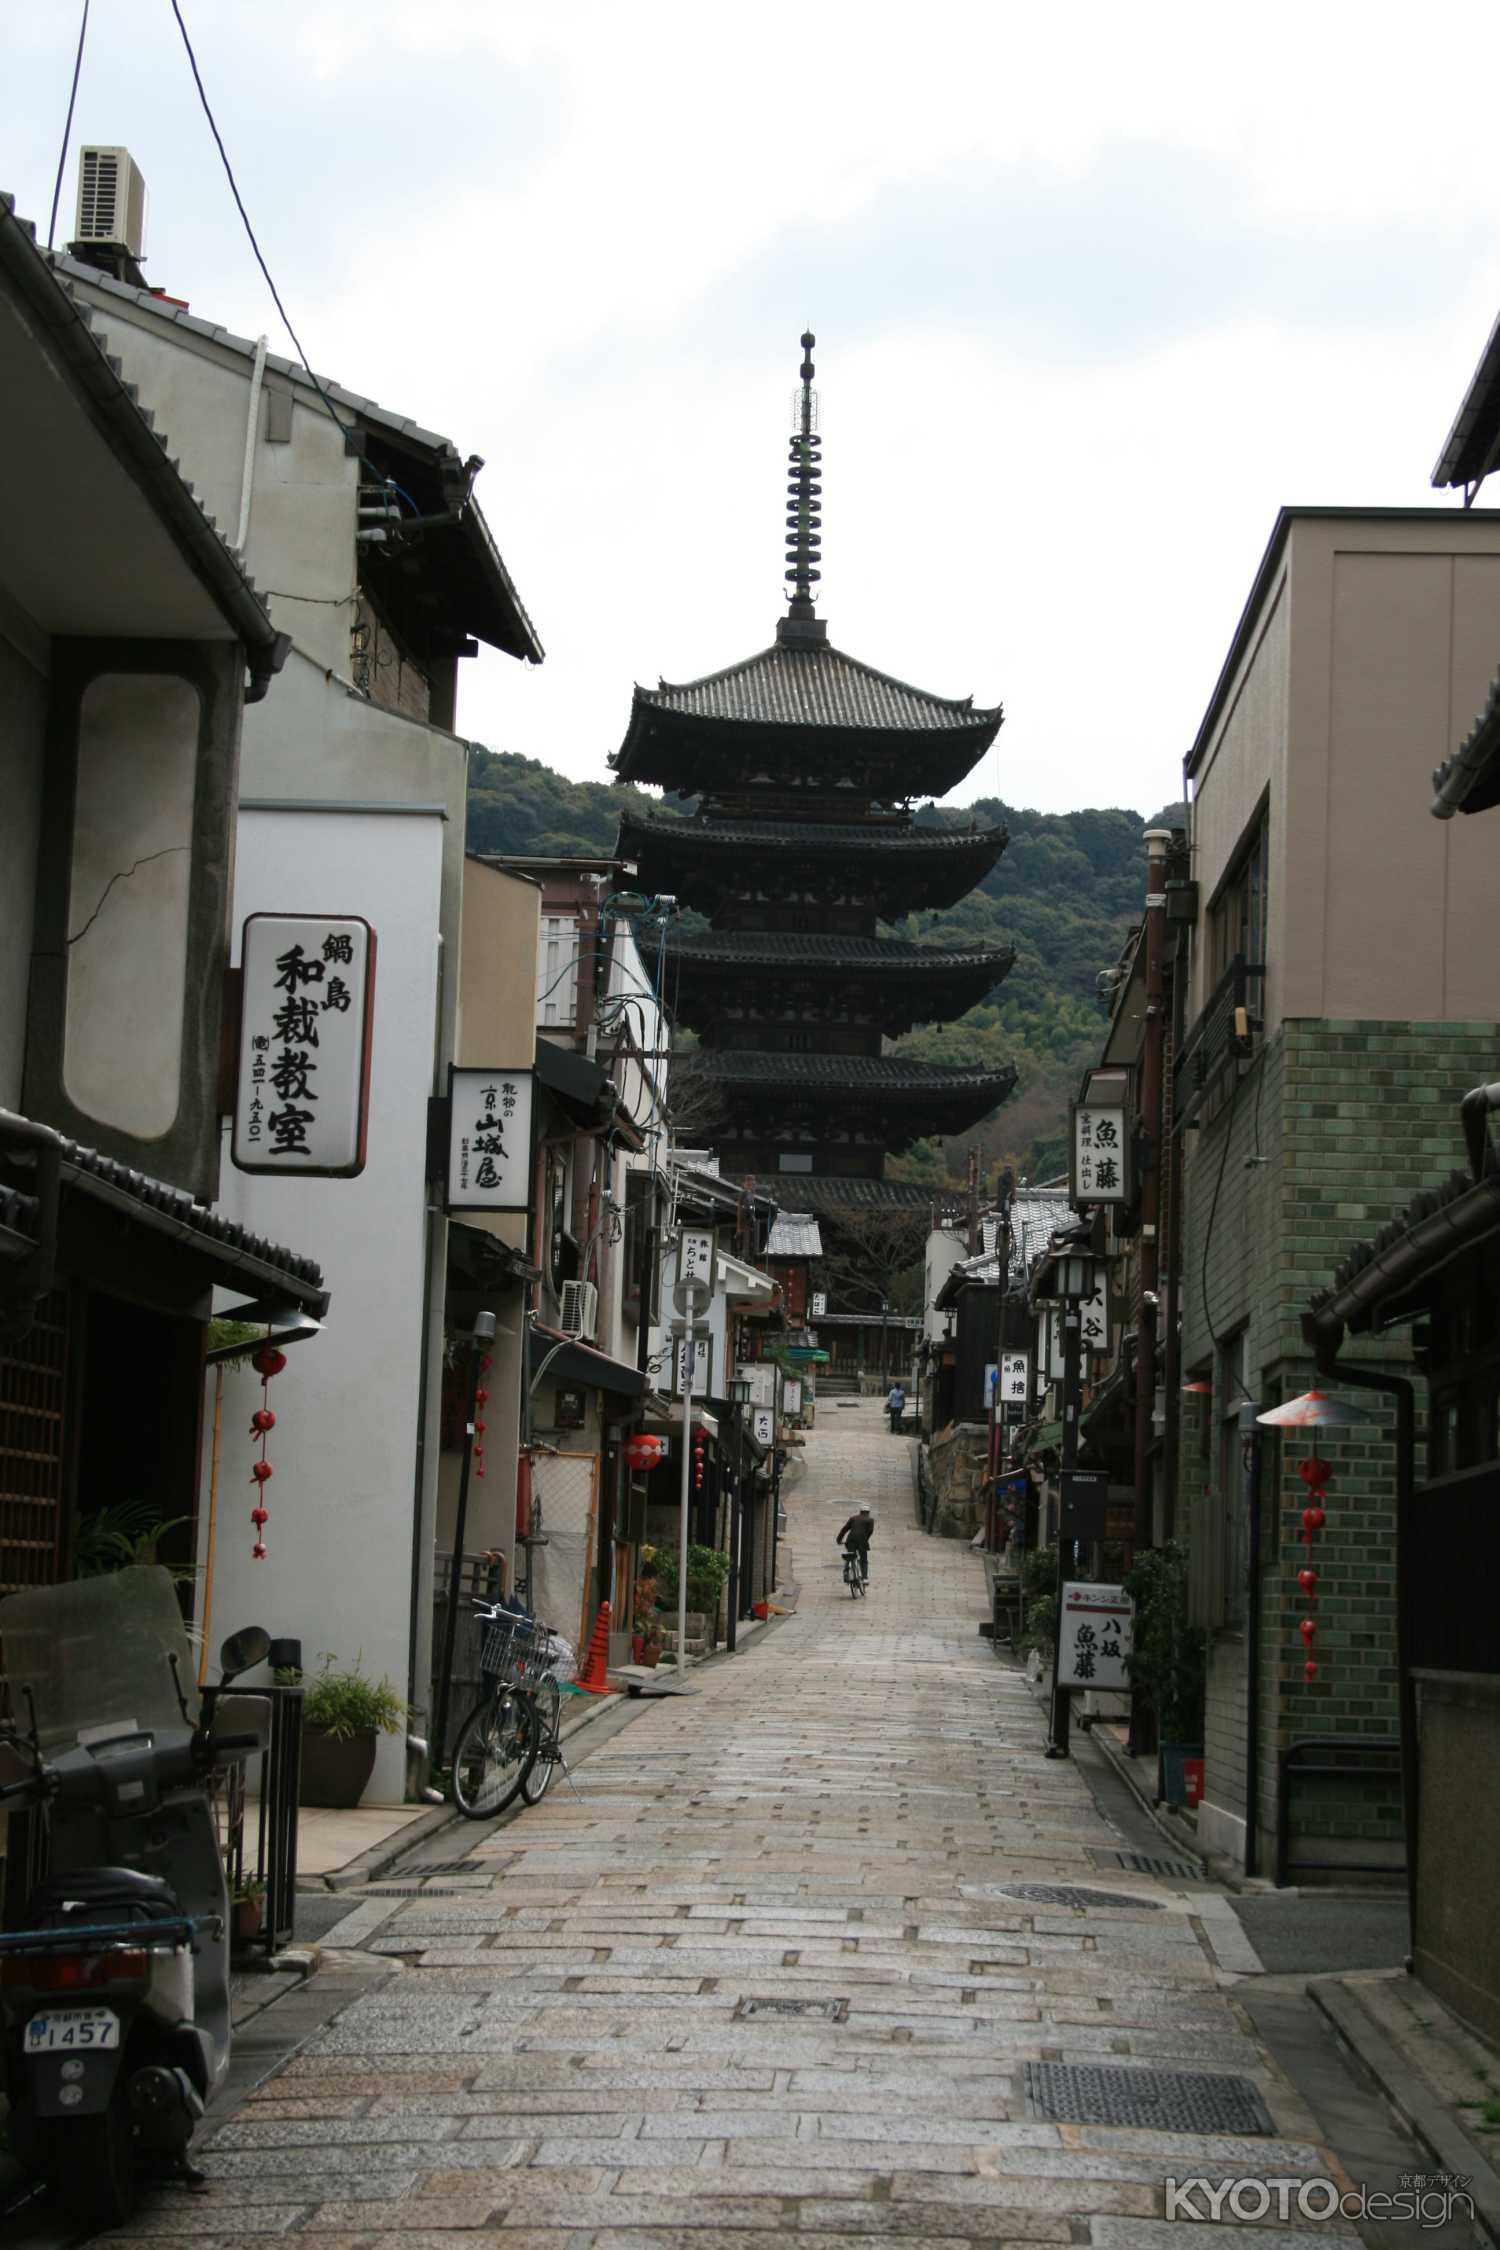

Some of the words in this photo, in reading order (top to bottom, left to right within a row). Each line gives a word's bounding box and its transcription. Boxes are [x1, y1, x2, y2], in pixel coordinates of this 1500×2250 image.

[320, 933, 354, 1013] 鍋島
[267, 944, 326, 1156] 和裁教室
[1094, 1118, 1121, 1190] 魚藤
[1073, 1622, 1098, 1680] 魚藤
[1101, 1618, 1122, 1658] 八坂
[48, 2021, 114, 2047] 1457
